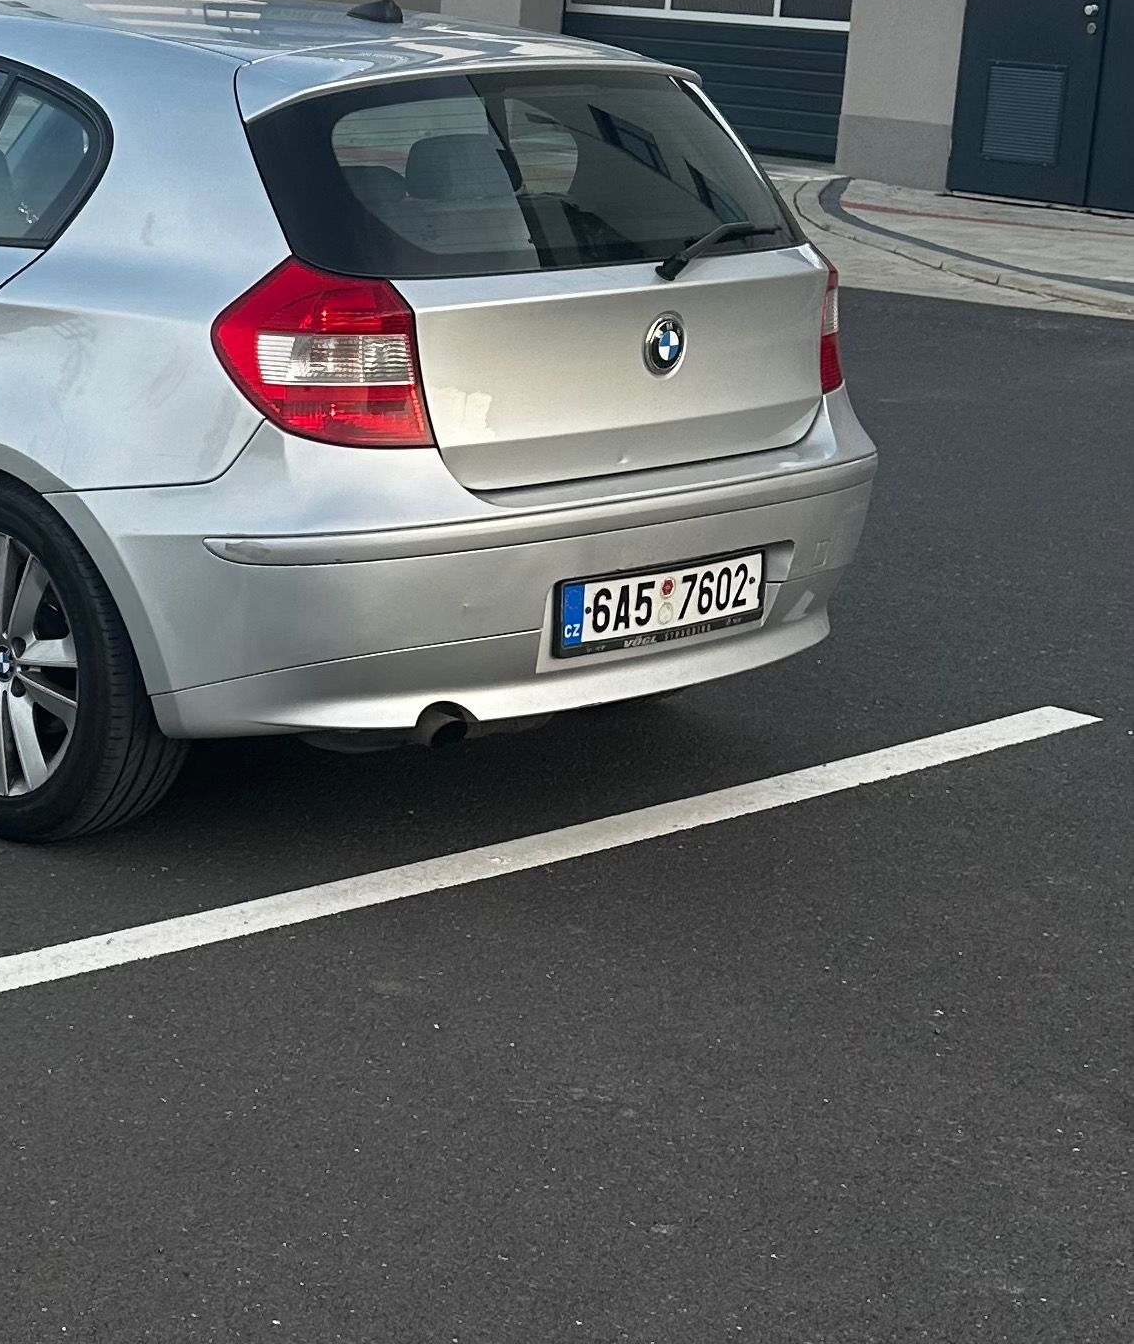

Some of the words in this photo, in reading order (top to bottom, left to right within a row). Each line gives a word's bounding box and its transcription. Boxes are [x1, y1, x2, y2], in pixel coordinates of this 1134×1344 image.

[592, 581, 656, 633] 6A5
[678, 563, 749, 620] 7602
[564, 623, 581, 639] CZ
